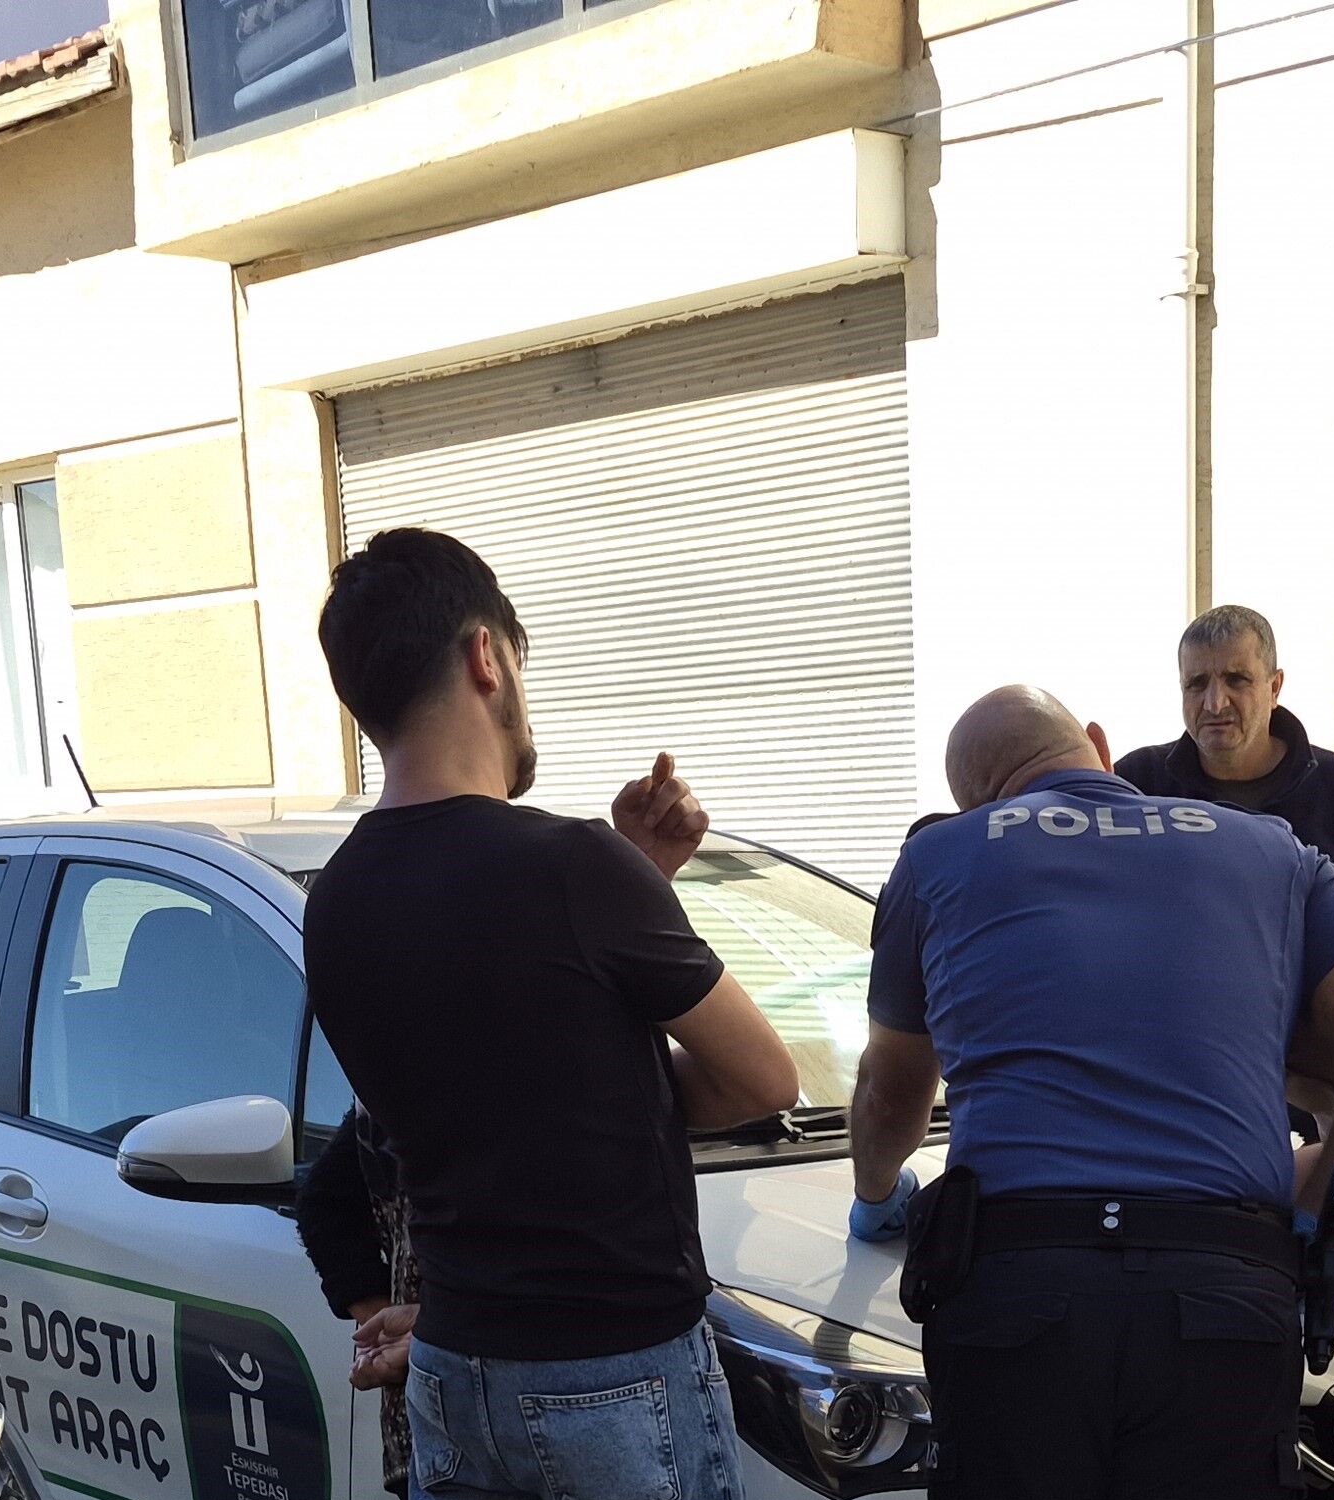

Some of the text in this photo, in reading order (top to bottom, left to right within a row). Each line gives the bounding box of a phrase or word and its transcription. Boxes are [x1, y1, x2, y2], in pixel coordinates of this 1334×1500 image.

[987, 806, 1218, 840] POLİS
[22, 1301, 158, 1393] DOSTU
[50, 1390, 171, 1483] ARAÇ
